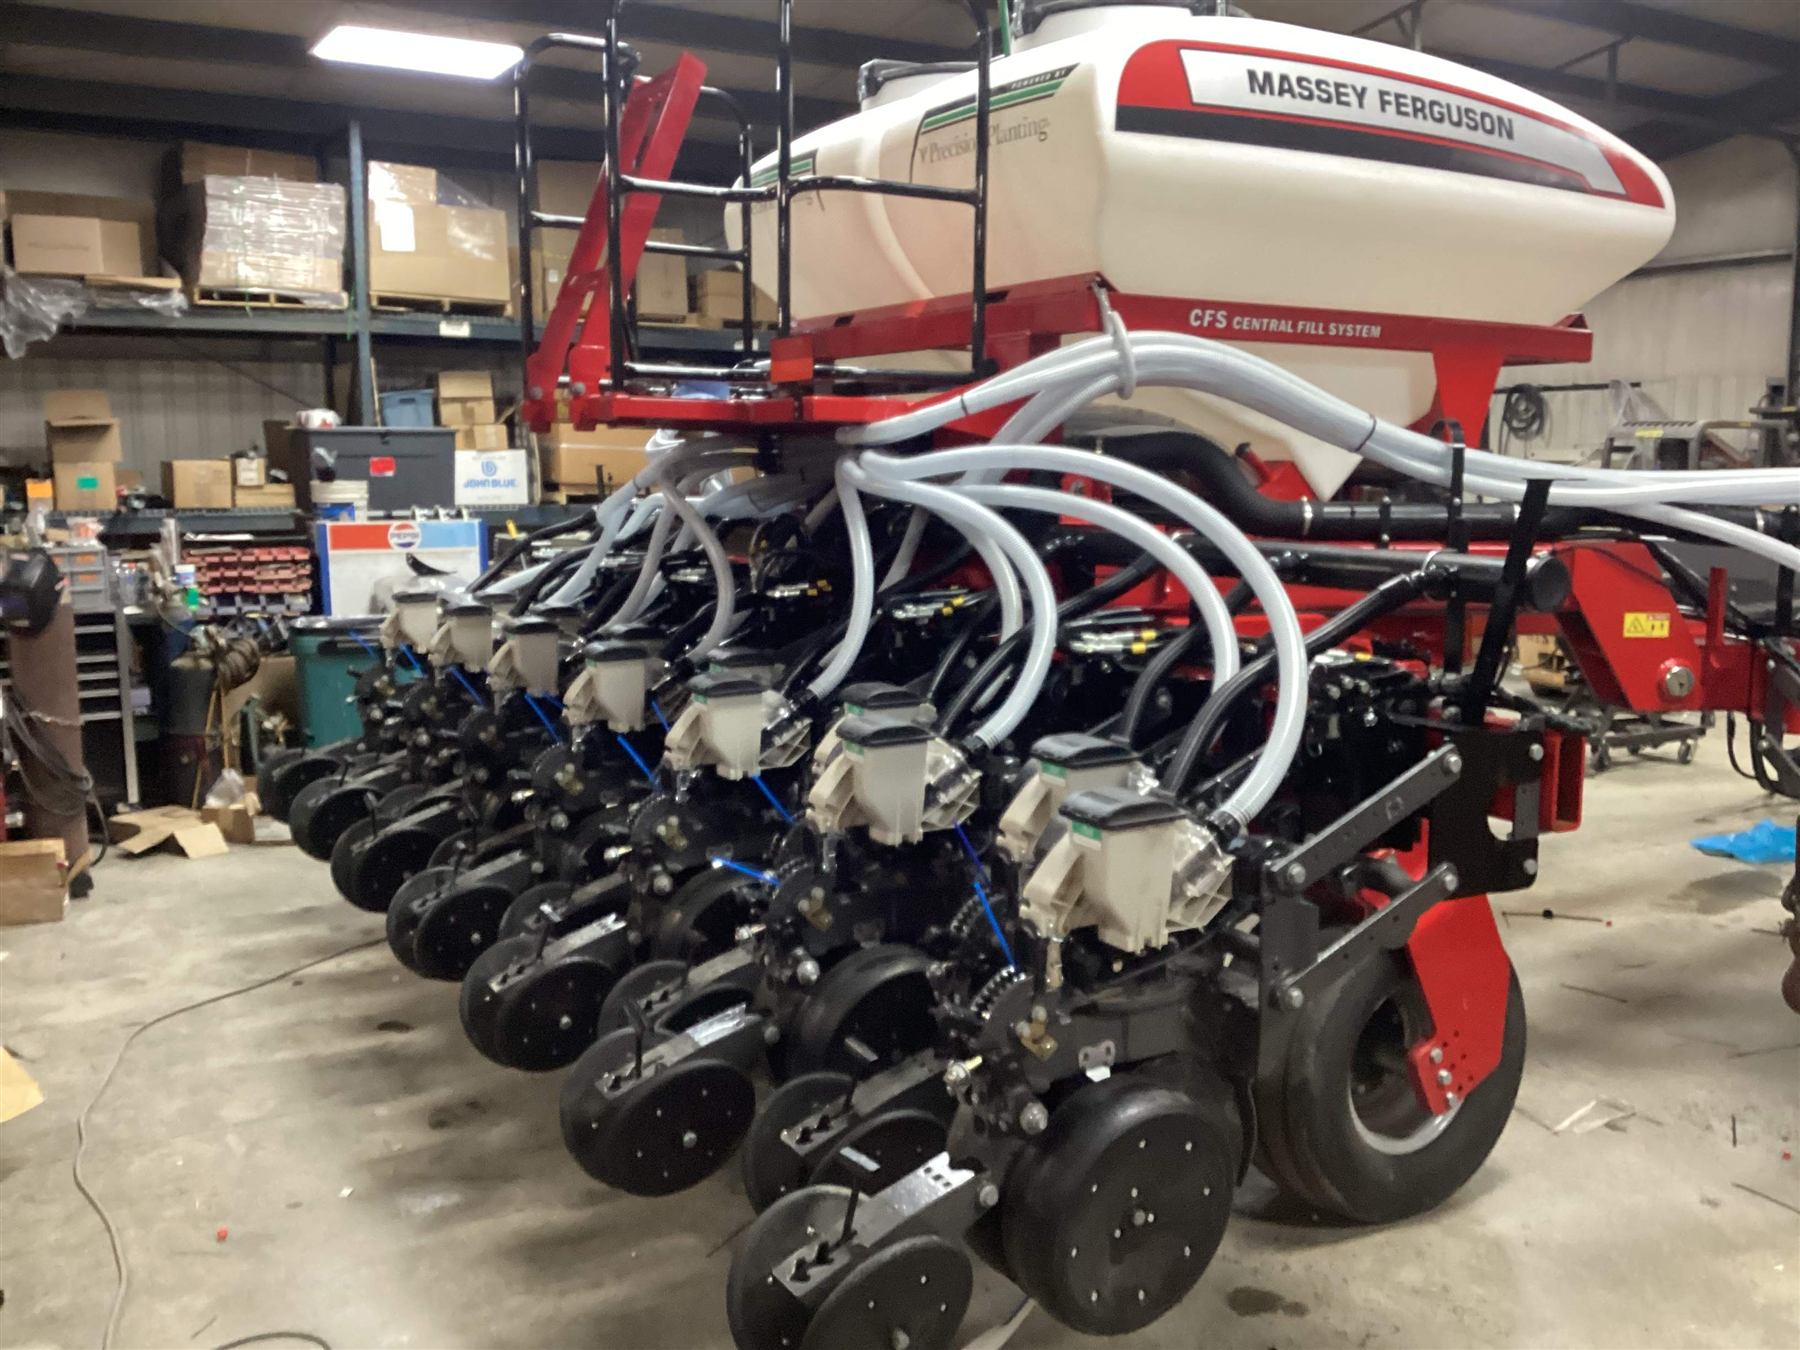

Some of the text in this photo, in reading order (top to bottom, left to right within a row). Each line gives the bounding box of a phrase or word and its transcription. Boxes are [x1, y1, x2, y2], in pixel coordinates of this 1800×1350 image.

[1011, 69, 1067, 89] POWERED BY
[1247, 69, 1514, 140] MASSEY FERGUSON
[929, 116, 1048, 163] Precisio Planting
[1189, 309, 1381, 338] CFS CENTRAL FILL SYSTEM
[464, 479, 517, 488] JOHN BLUE
